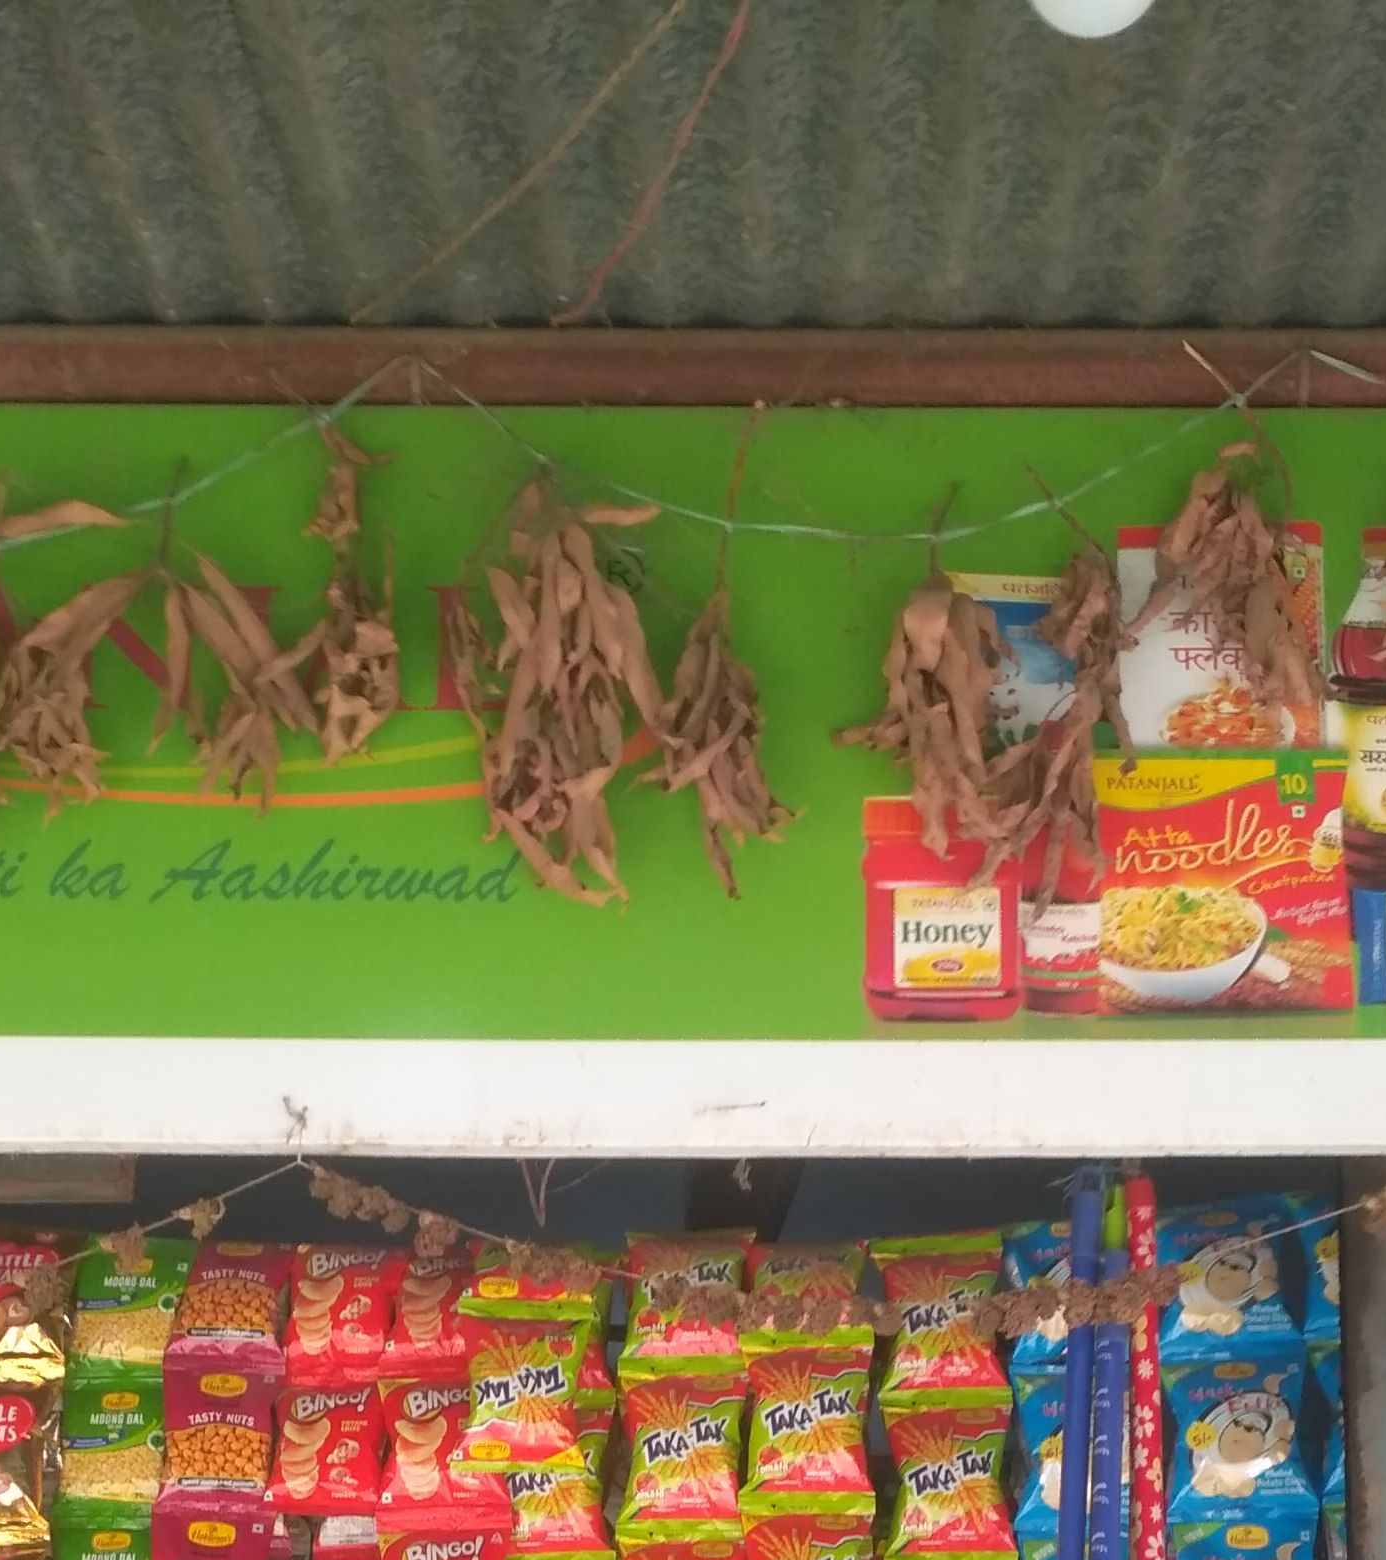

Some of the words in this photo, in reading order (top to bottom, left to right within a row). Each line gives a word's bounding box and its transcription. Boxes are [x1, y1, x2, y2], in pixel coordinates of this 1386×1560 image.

[1280, 774, 1308, 795] 10
[1115, 798, 1303, 875] noodles
[1123, 824, 1194, 849] Atta
[48, 836, 130, 898] ka
[152, 836, 518, 903] Aashirwad
[900, 920, 993, 949] Honey
[201, 1269, 233, 1281] TASTY
[237, 1270, 266, 1283] NUTS
[312, 1249, 385, 1277] BINGO!
[103, 1275, 135, 1288] MOONG
[138, 1275, 156, 1288] DAL
[476, 1363, 566, 1408] TAKA-TAK
[296, 1387, 371, 1420] BINGO!
[765, 1387, 854, 1434] TAKA-TAK
[90, 1412, 122, 1426] MOONG
[125, 1412, 145, 1426] DAL
[188, 1412, 223, 1426] TASTY
[226, 1412, 255, 1427] NUTS
[644, 1416, 729, 1462] TAKA-TAK
[909, 1450, 994, 1497] TAKA-TAK
